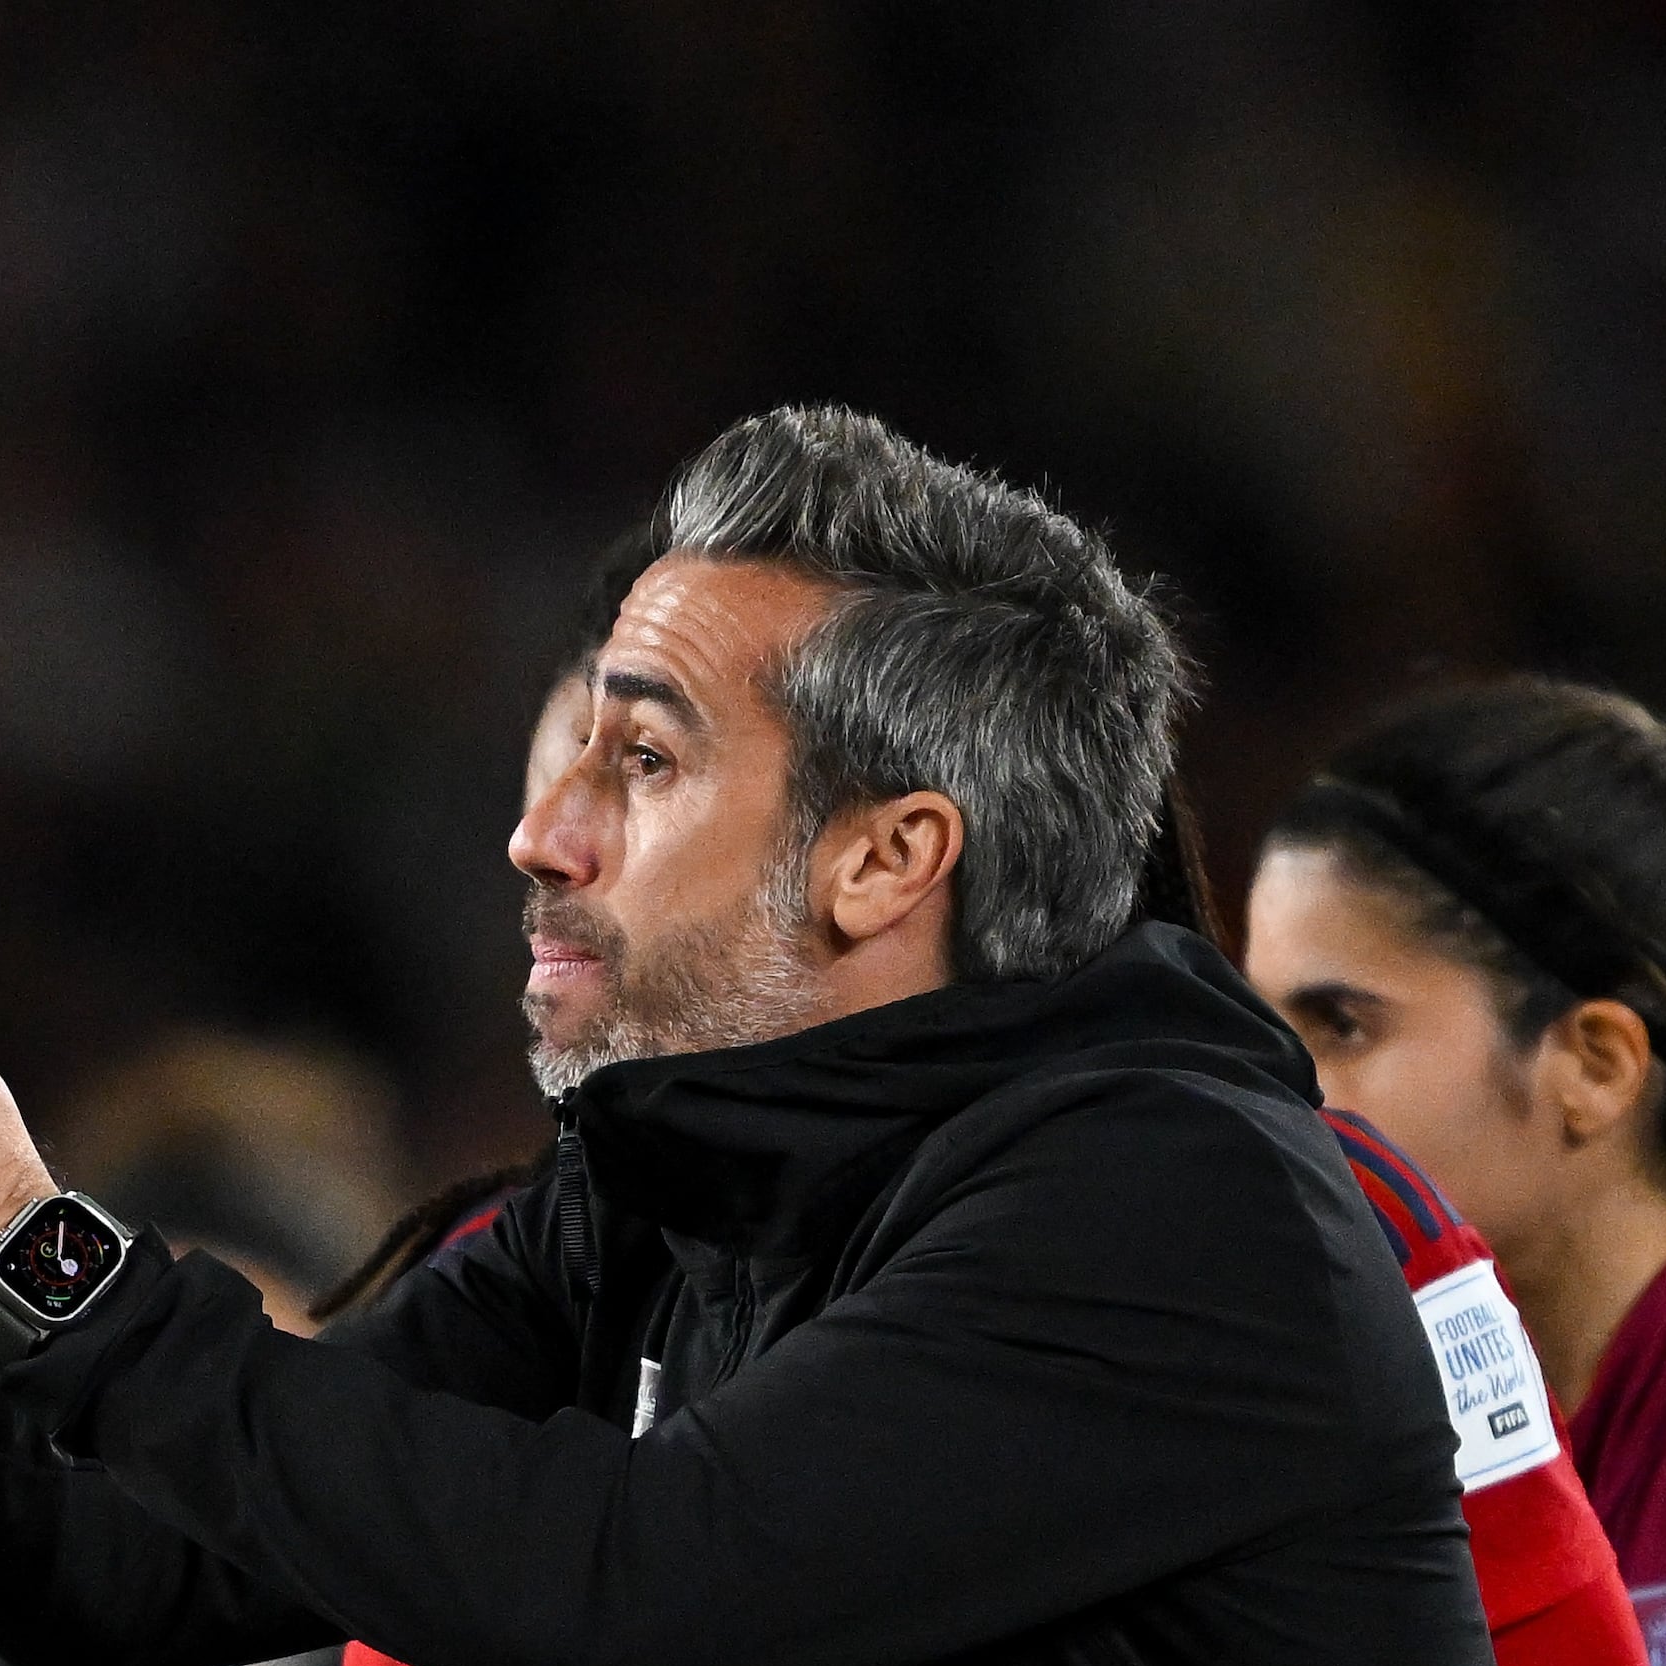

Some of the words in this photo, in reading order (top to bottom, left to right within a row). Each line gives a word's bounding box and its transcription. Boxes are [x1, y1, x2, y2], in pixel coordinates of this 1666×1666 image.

[1435, 1301, 1501, 1344] FOOTBALL
[1445, 1325, 1515, 1381] UNITES
[1452, 1383, 1488, 1415] the
[1495, 1408, 1528, 1433] FIFA
